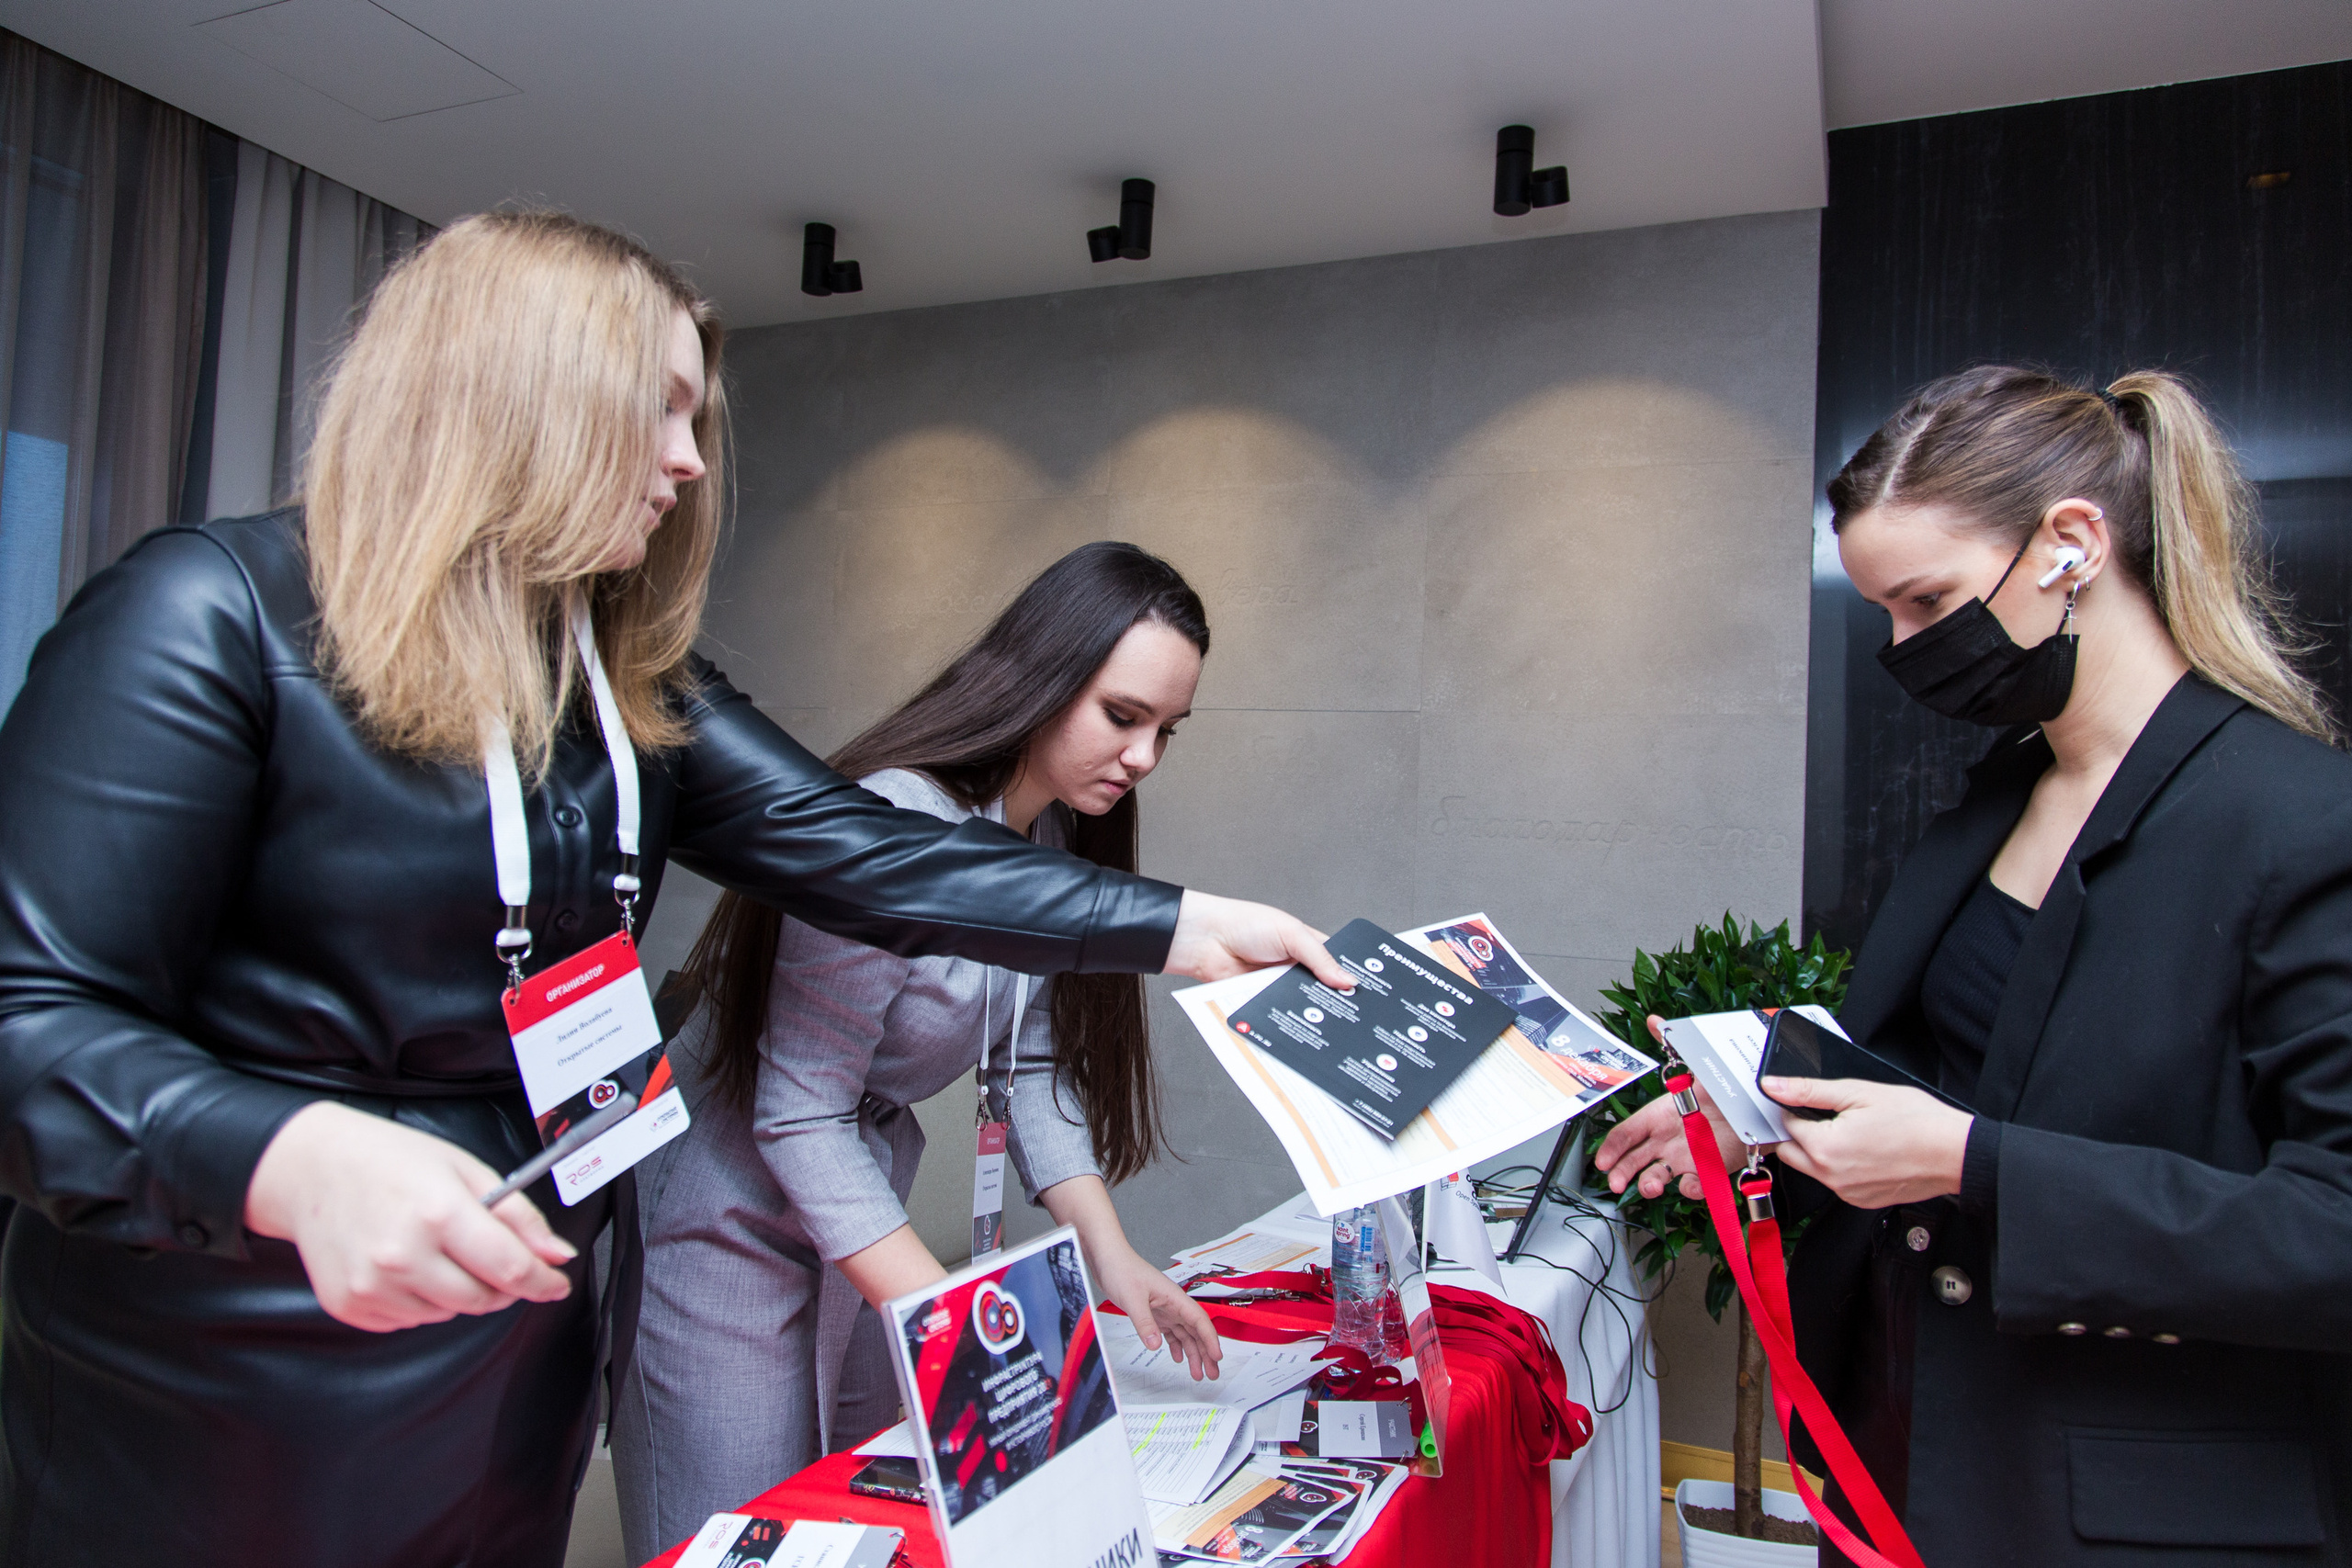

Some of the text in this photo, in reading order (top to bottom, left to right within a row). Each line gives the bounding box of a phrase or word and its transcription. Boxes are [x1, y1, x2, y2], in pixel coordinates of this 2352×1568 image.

[546, 964, 605, 1003] ОРГАНИЗАТОР
[1378, 942, 1475, 1006] Преимущества
[1552, 1034, 1571, 1047] 8
[1561, 1046, 1608, 1081] декабря
[1702, 1057, 1738, 1098] УЧАСТНИК
[1455, 1190, 1471, 1202] Open
[1087, 1527, 1143, 1568] ИКИ
